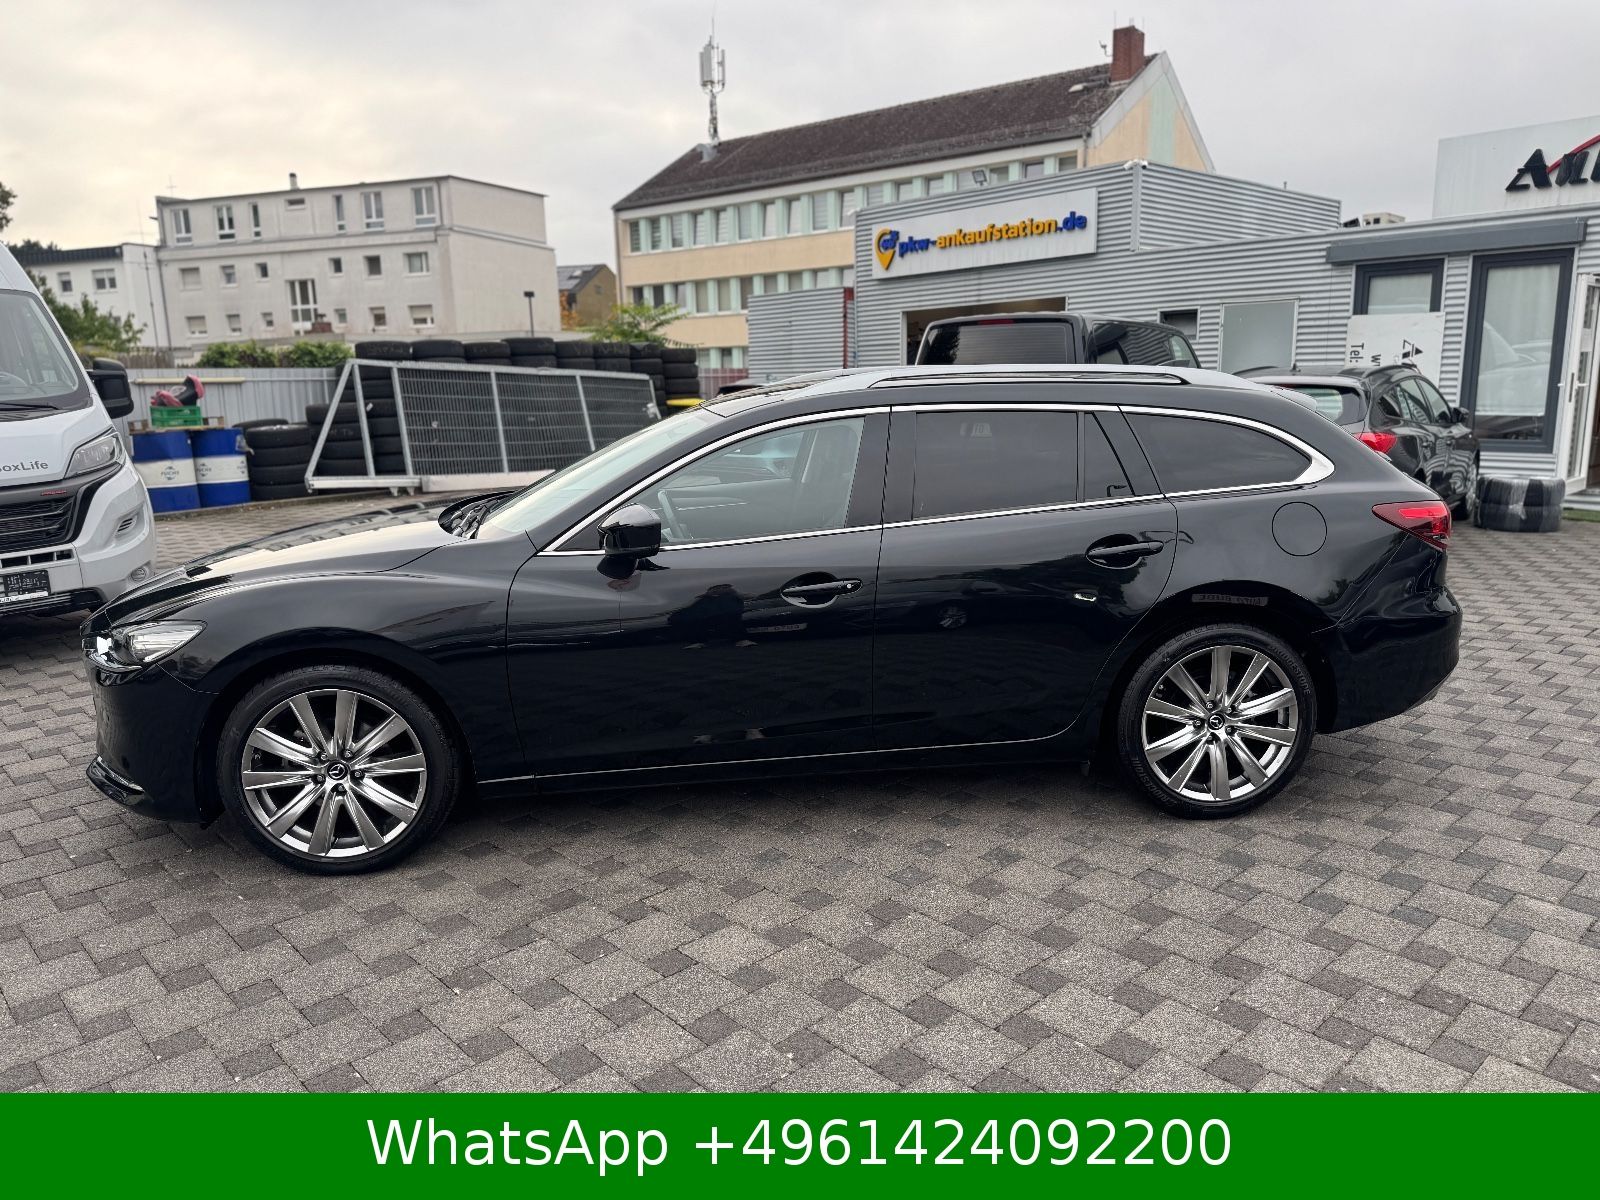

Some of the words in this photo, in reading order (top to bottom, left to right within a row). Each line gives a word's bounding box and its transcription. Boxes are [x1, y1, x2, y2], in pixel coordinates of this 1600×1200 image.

[899, 211, 1087, 257] pkw-ankaufstation.de
[1350, 343, 1364, 362] Tel:
[0, 460, 49, 472] oxLife
